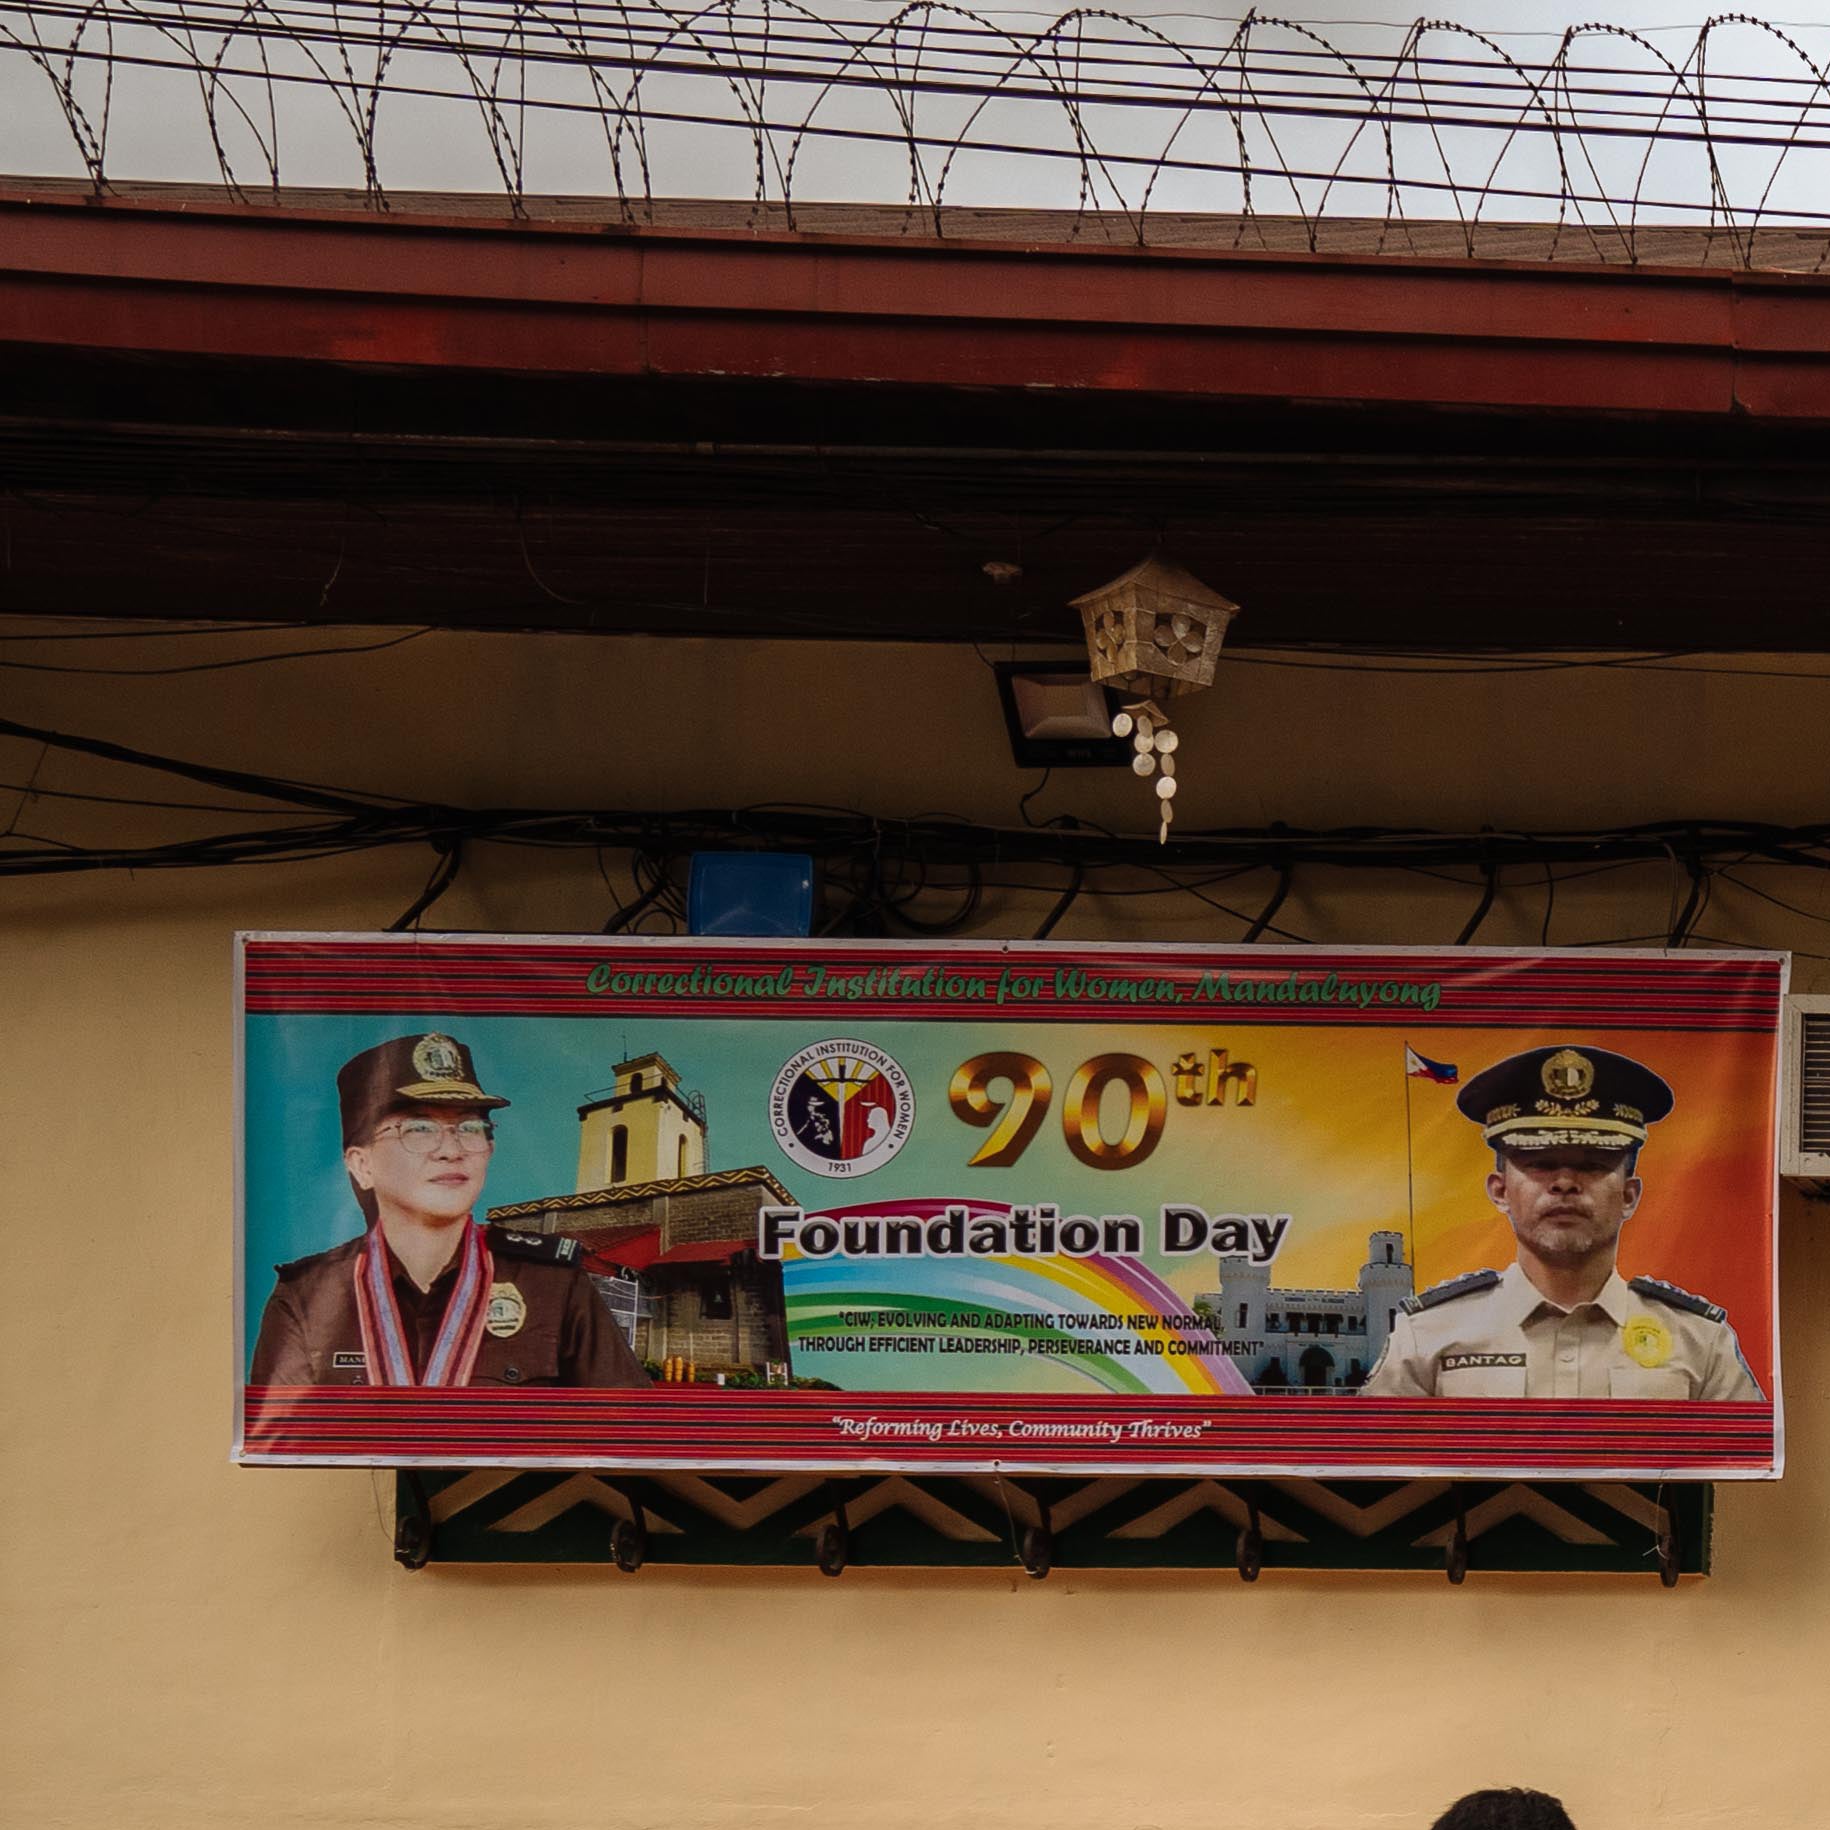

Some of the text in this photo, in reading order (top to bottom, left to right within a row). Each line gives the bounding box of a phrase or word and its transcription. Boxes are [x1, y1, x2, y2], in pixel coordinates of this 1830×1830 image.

[585, 963, 1442, 1012] Correctional Institution for Women, Mandaluyong
[774, 1042, 911, 1140] CORRECTIONAL INSTITUTION FOR WOMEN
[827, 1162, 852, 1173] 1931
[761, 1205, 1290, 1265] Foundation Day
[877, 1311, 948, 1329] EVOLVING
[949, 1312, 980, 1329] AND
[983, 1312, 1055, 1330] ADAPTING
[1058, 1313, 1124, 1331] TOWARDS
[1126, 1314, 1160, 1331] NEW
[1161, 1314, 1225, 1333] NORMAL,
[798, 1336, 866, 1353] THROUGH
[868, 1337, 937, 1354] EFFICIENT
[938, 1338, 1025, 1357] LEADERSHIP,
[1027, 1339, 1132, 1356] PERSEVERANCE
[1133, 1339, 1165, 1356] AND
[1445, 1355, 1522, 1367] BANTAG
[831, 1415, 943, 1442] “Reforming
[946, 1417, 1002, 1439] Lives,
[1008, 1419, 1123, 1443] Community
